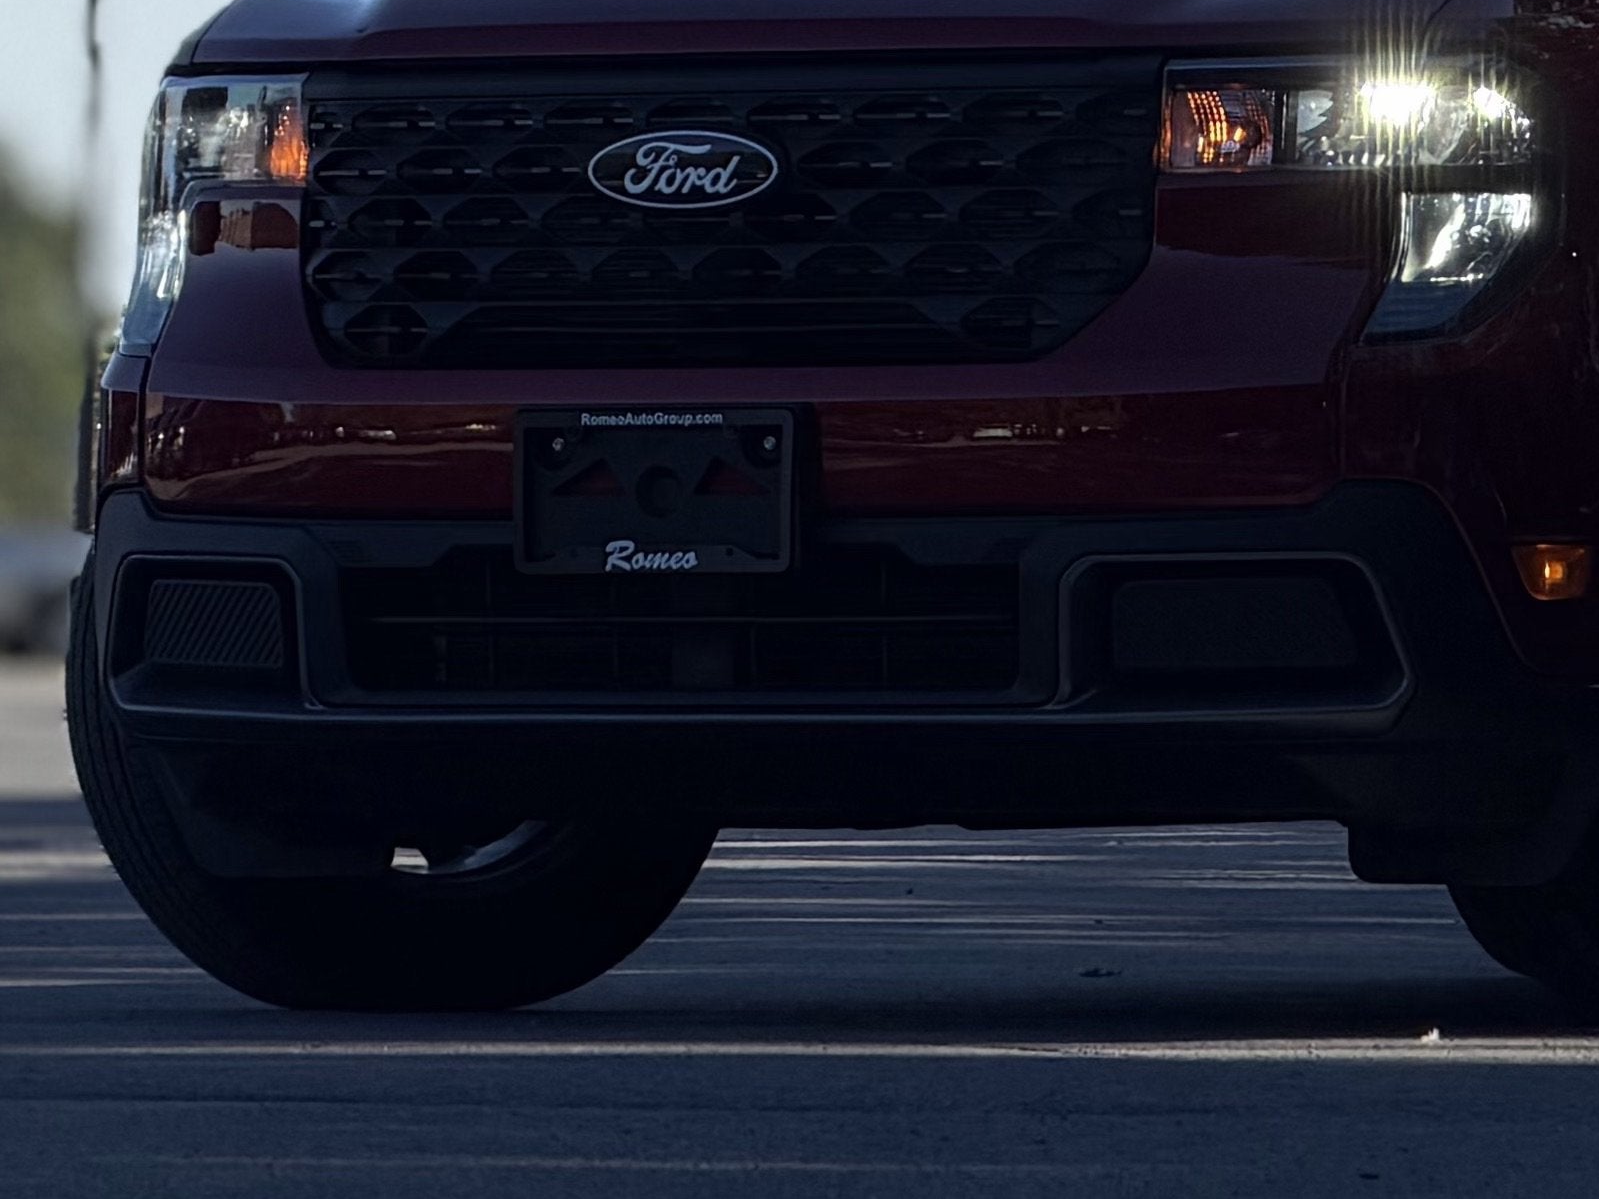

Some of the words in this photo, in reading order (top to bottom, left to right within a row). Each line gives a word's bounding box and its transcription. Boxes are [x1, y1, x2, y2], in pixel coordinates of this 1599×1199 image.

[624, 142, 742, 195] Ford
[581, 412, 724, 428] RomeoAutoGroup.com
[605, 540, 699, 572] Romeo
